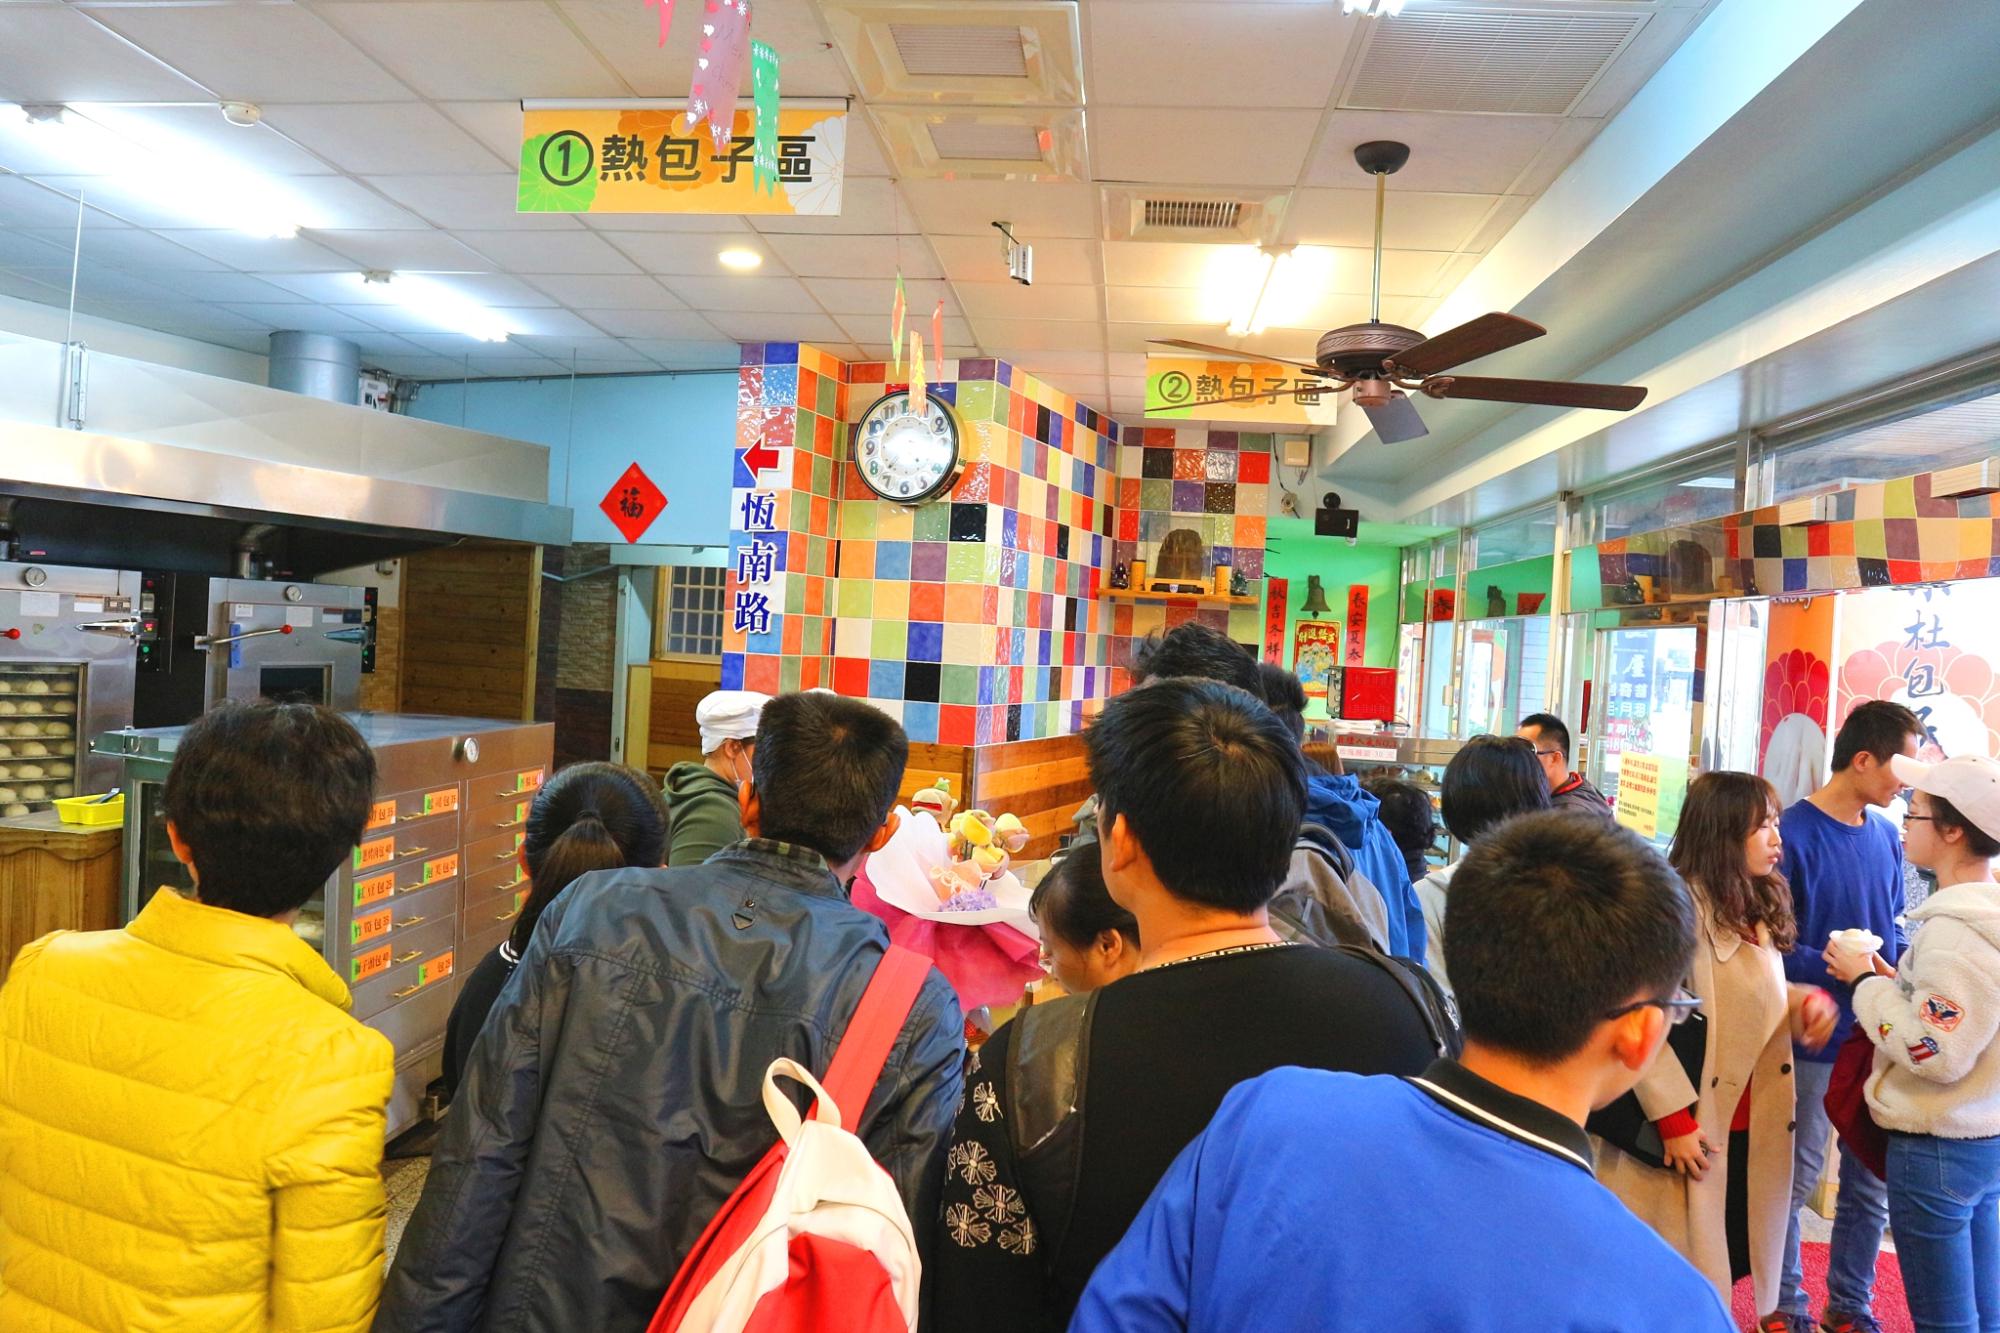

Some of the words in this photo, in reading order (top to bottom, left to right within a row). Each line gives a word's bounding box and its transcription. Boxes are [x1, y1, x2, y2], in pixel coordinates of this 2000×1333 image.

[865, 441, 876, 456] 9
[869, 460, 879, 476] 8
[882, 474, 892, 490] 7
[899, 480, 910, 495] 6
[618, 486, 645, 519] 福
[734, 492, 776, 632] 恆南路
[1903, 586, 1951, 748] 杜包子
